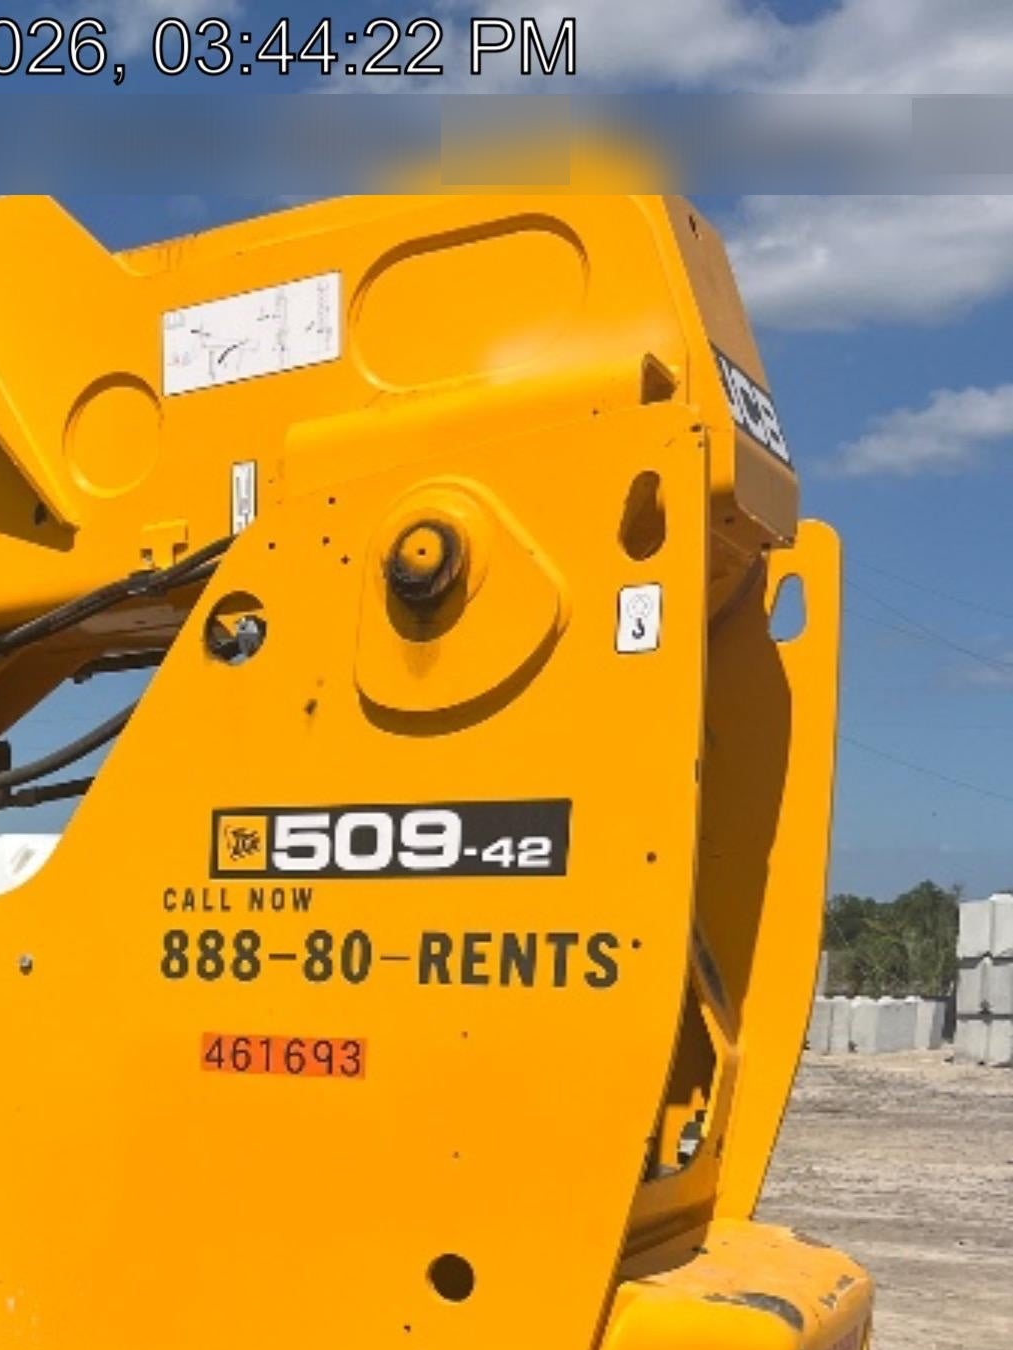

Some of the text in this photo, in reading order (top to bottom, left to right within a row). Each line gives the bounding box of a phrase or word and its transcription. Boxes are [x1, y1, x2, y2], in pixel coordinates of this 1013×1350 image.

[718, 354, 791, 464] JCB
[271, 809, 553, 871] 509-42
[162, 887, 313, 912] CALL NOW
[160, 929, 620, 989] 888-80-RENTS
[204, 1036, 362, 1077] 461693
